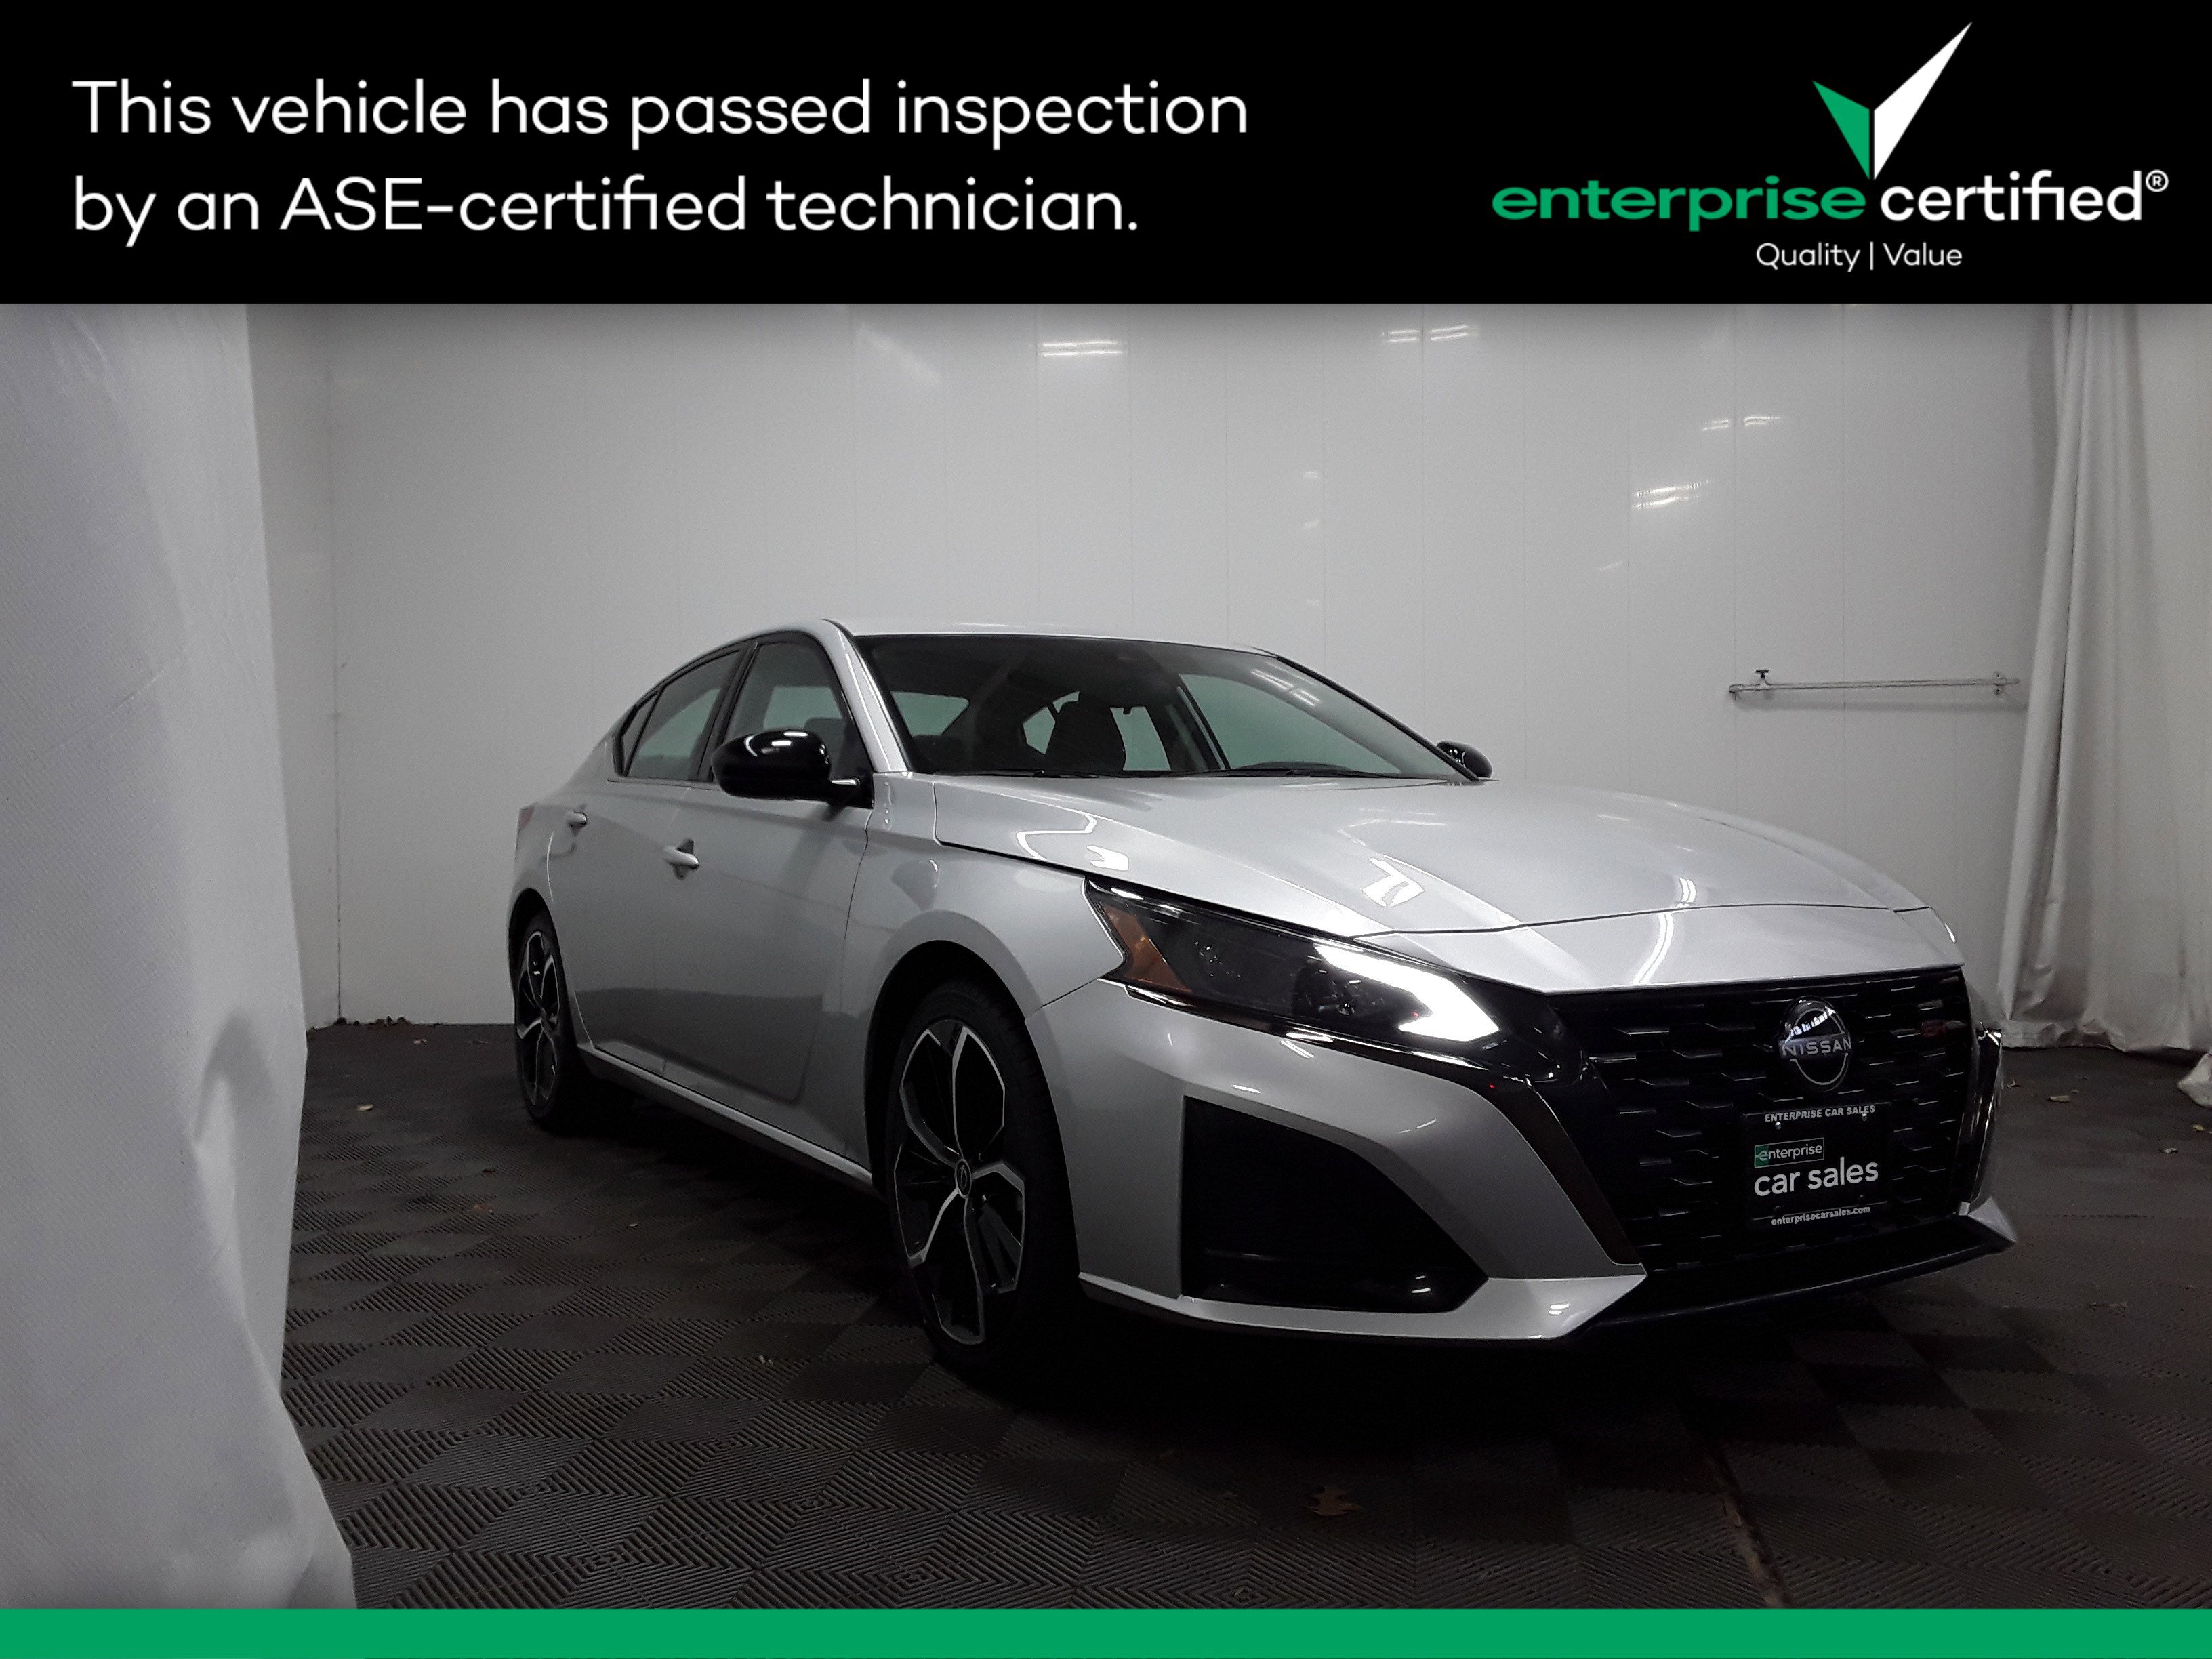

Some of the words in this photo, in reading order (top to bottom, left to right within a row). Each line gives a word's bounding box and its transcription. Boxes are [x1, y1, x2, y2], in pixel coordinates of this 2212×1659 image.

[1782, 1037, 1852, 1057] NISSAN
[1765, 1109, 1822, 1122] ENTERPRISE
[1825, 1107, 1844, 1117] CAR
[1846, 1105, 1876, 1115] SALES
[1757, 1143, 1823, 1161] enterprise
[1754, 1171, 1801, 1197] car
[1807, 1156, 1879, 1190] sales
[1771, 1206, 1870, 1225] enterprisecarsales.com
